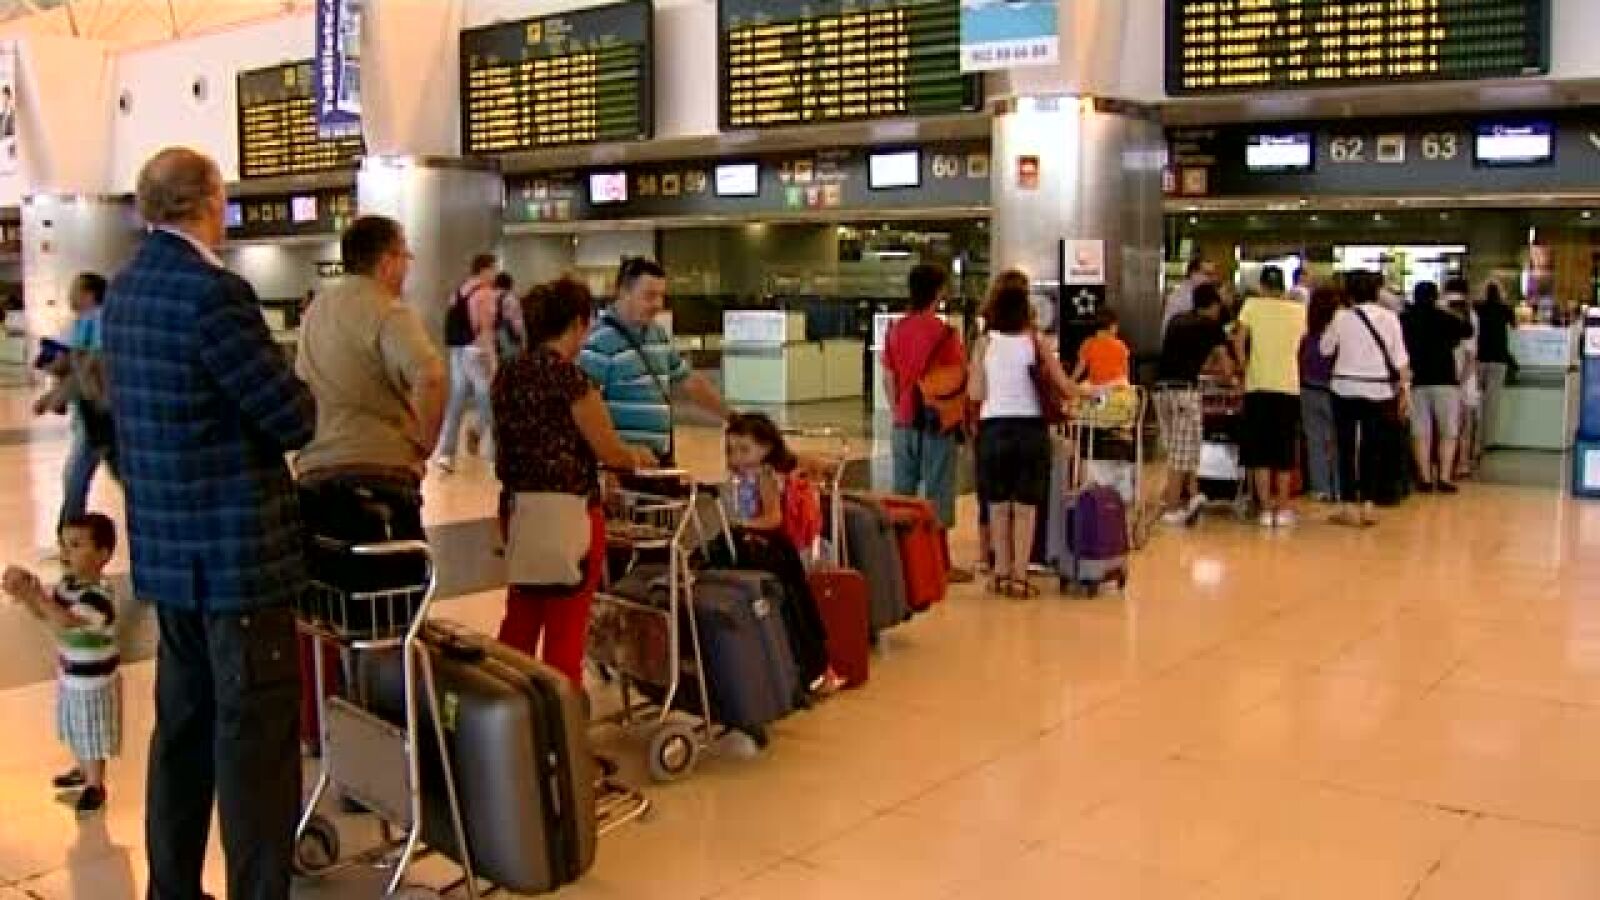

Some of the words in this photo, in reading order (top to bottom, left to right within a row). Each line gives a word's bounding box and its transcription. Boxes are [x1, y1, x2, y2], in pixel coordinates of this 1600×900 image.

[1330, 136, 1364, 161] 62
[1422, 133, 1456, 159] 63
[933, 154, 958, 178] 60
